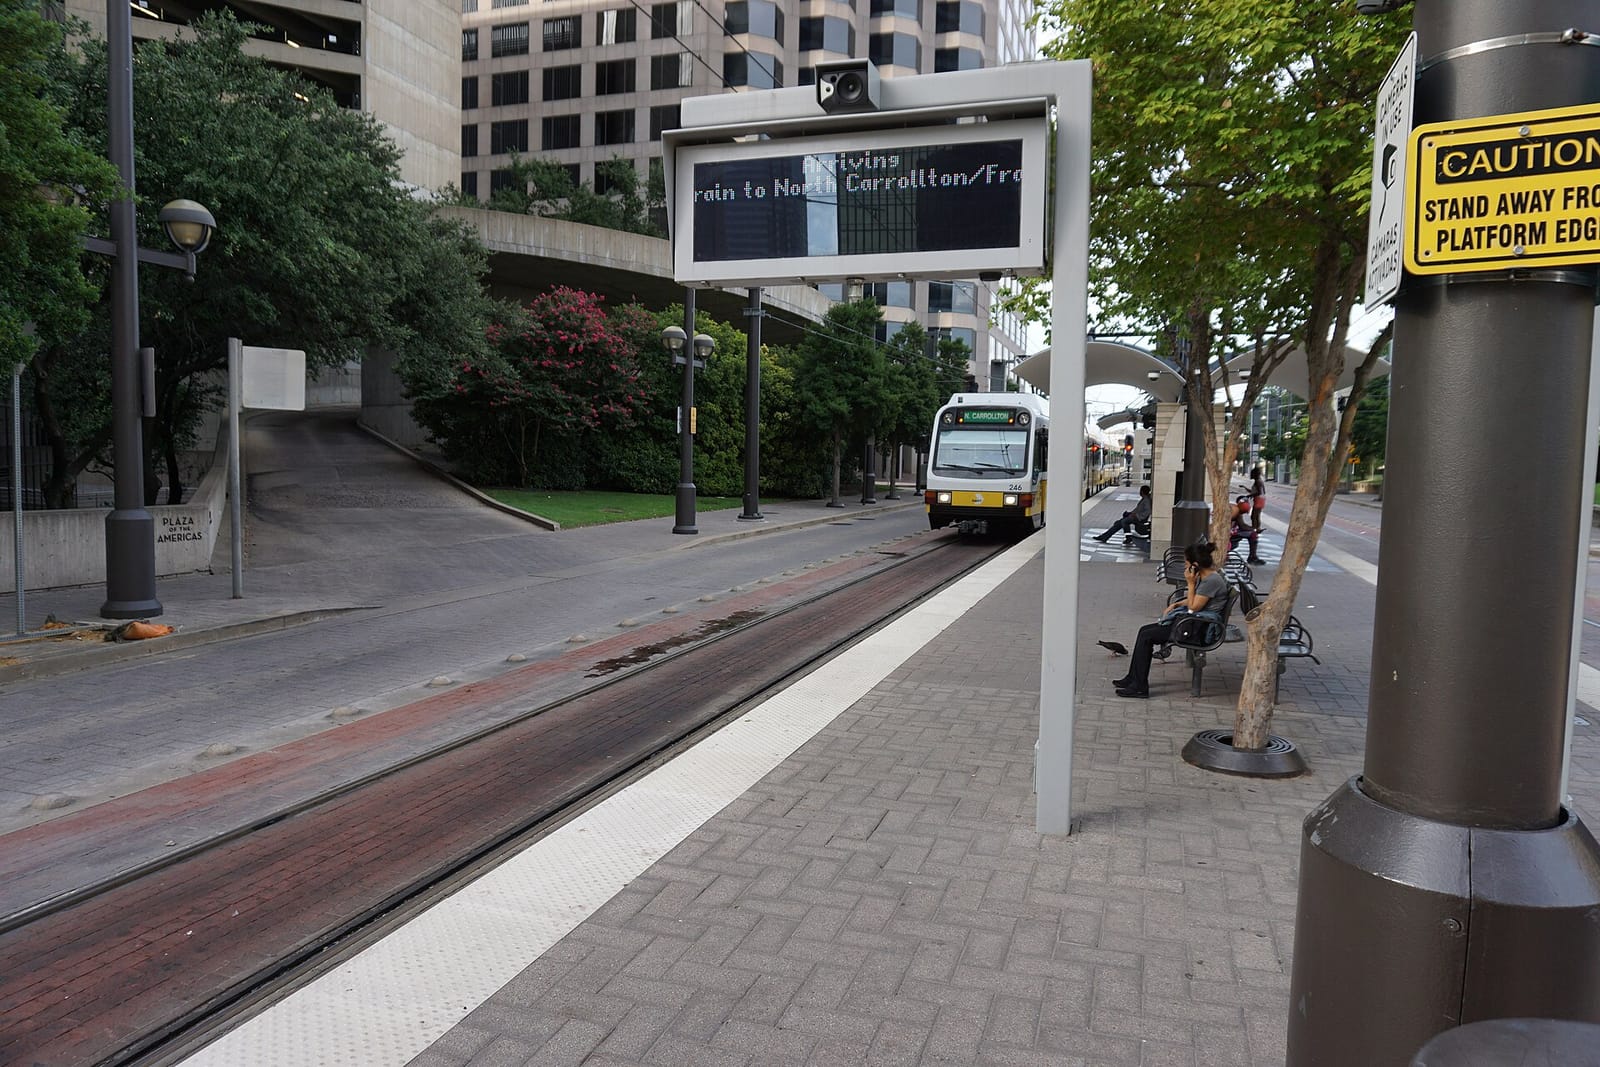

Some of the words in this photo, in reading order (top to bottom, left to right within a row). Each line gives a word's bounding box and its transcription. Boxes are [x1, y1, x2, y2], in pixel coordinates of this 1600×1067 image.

[1380, 65, 1408, 124] CAMERAS
[1390, 101, 1402, 134] USE
[803, 151, 900, 174] Arriving
[1442, 137, 1600, 178] CAUTION
[694, 183, 735, 202] rain
[744, 181, 766, 198] to
[774, 177, 837, 198] North
[1425, 195, 1489, 222] STAND
[1496, 188, 1555, 216] AWAY
[1437, 221, 1547, 252] PLATFORM
[1555, 216, 1600, 243] EDG
[1368, 249, 1397, 292] ACTIVADAS
[972, 412, 1009, 420] CARROLLTON
[158, 531, 202, 543] AMERICAS
[162, 516, 194, 526] PLAZA
